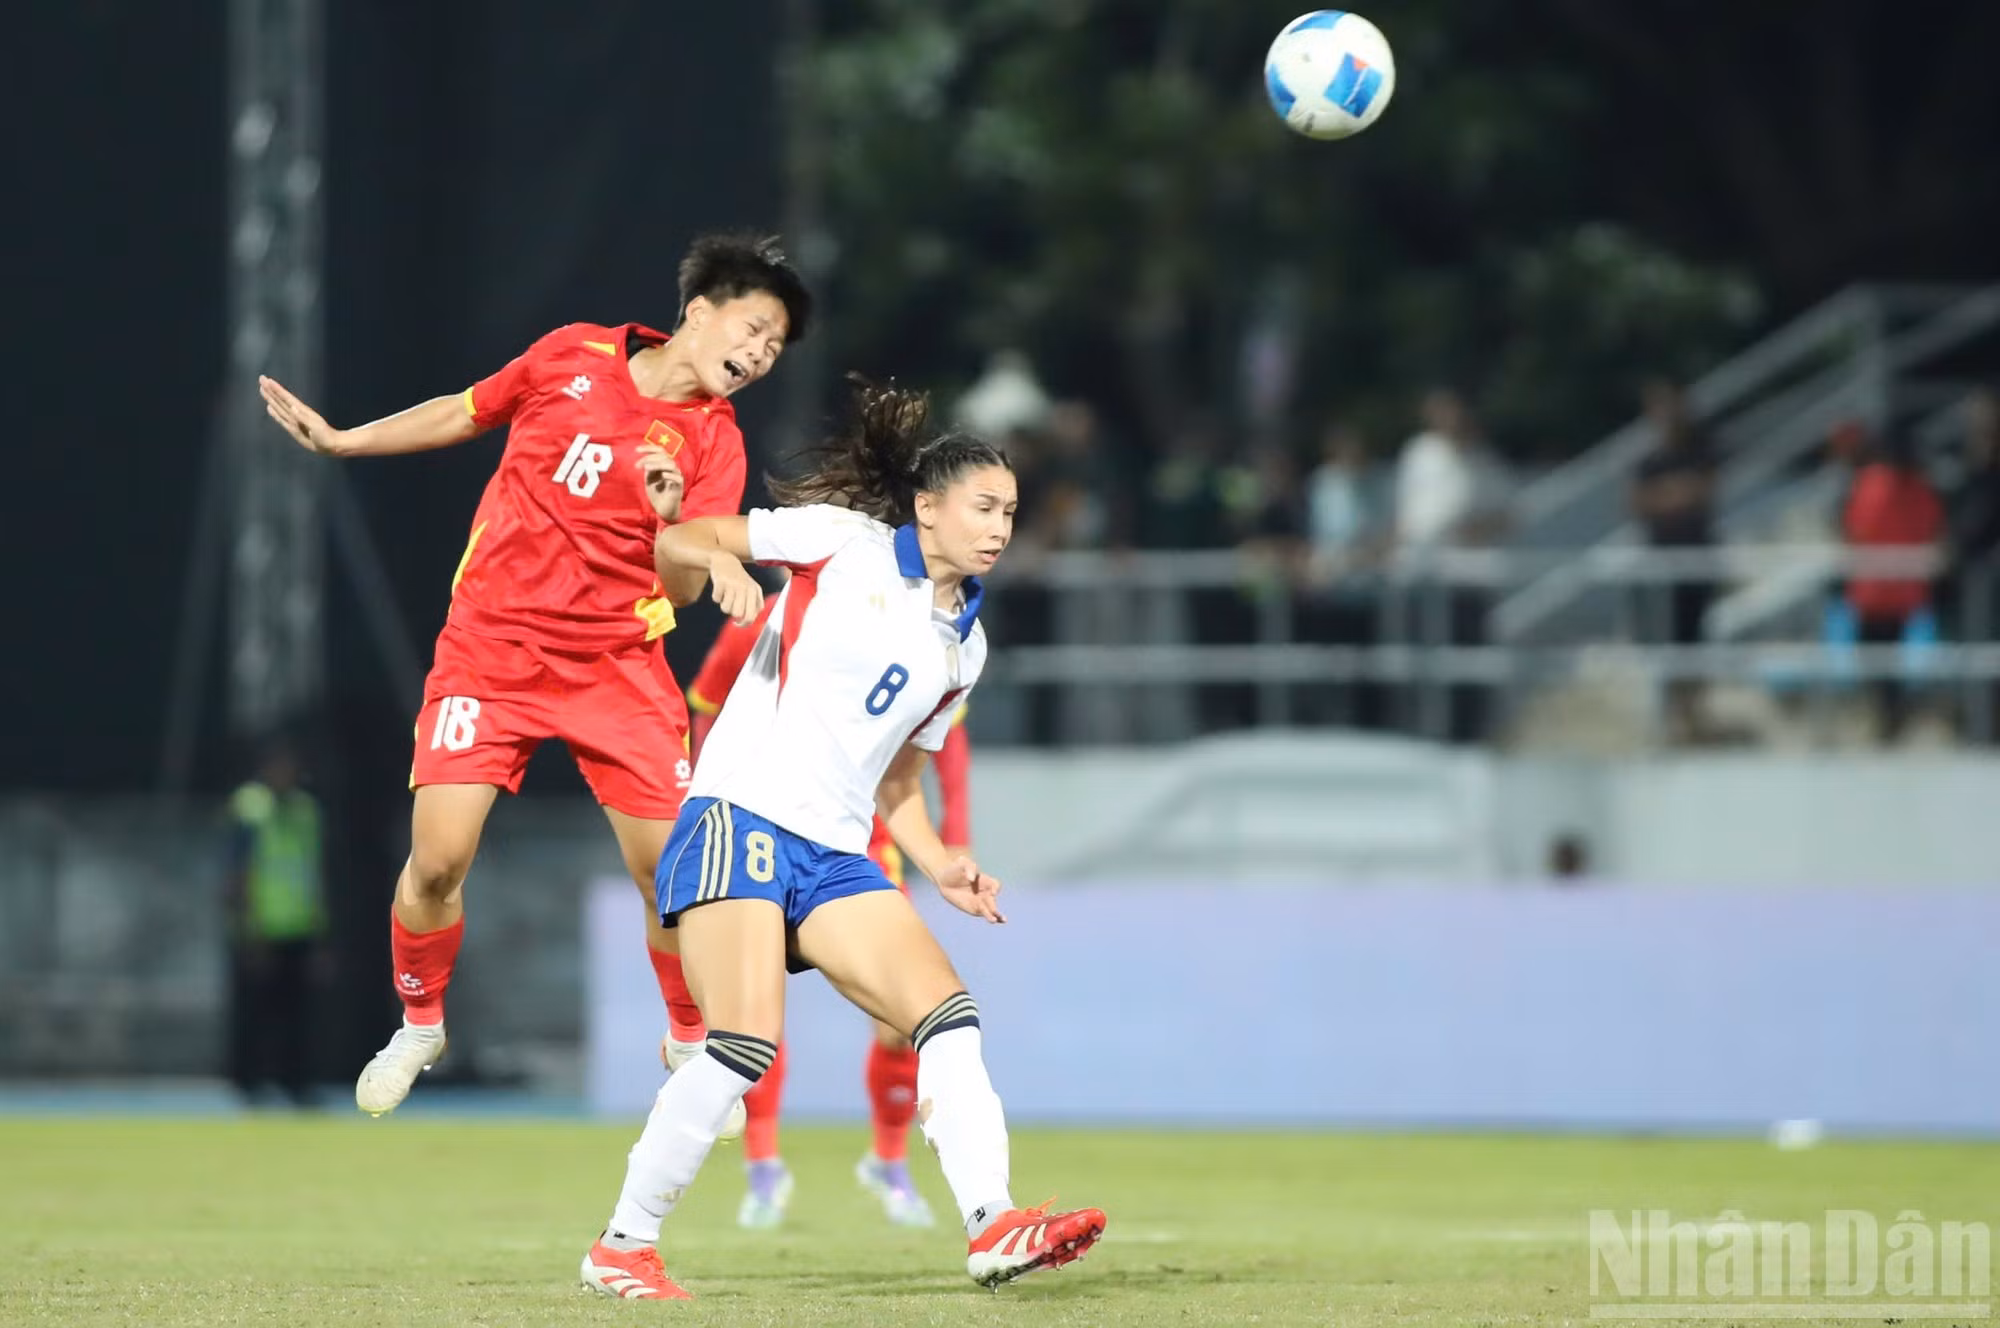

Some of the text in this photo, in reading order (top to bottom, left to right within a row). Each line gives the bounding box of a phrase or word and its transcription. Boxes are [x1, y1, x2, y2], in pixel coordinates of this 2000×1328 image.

[552, 432, 613, 498] 18
[865, 663, 909, 716] 8
[431, 695, 480, 751] 18
[746, 831, 774, 883] 8
